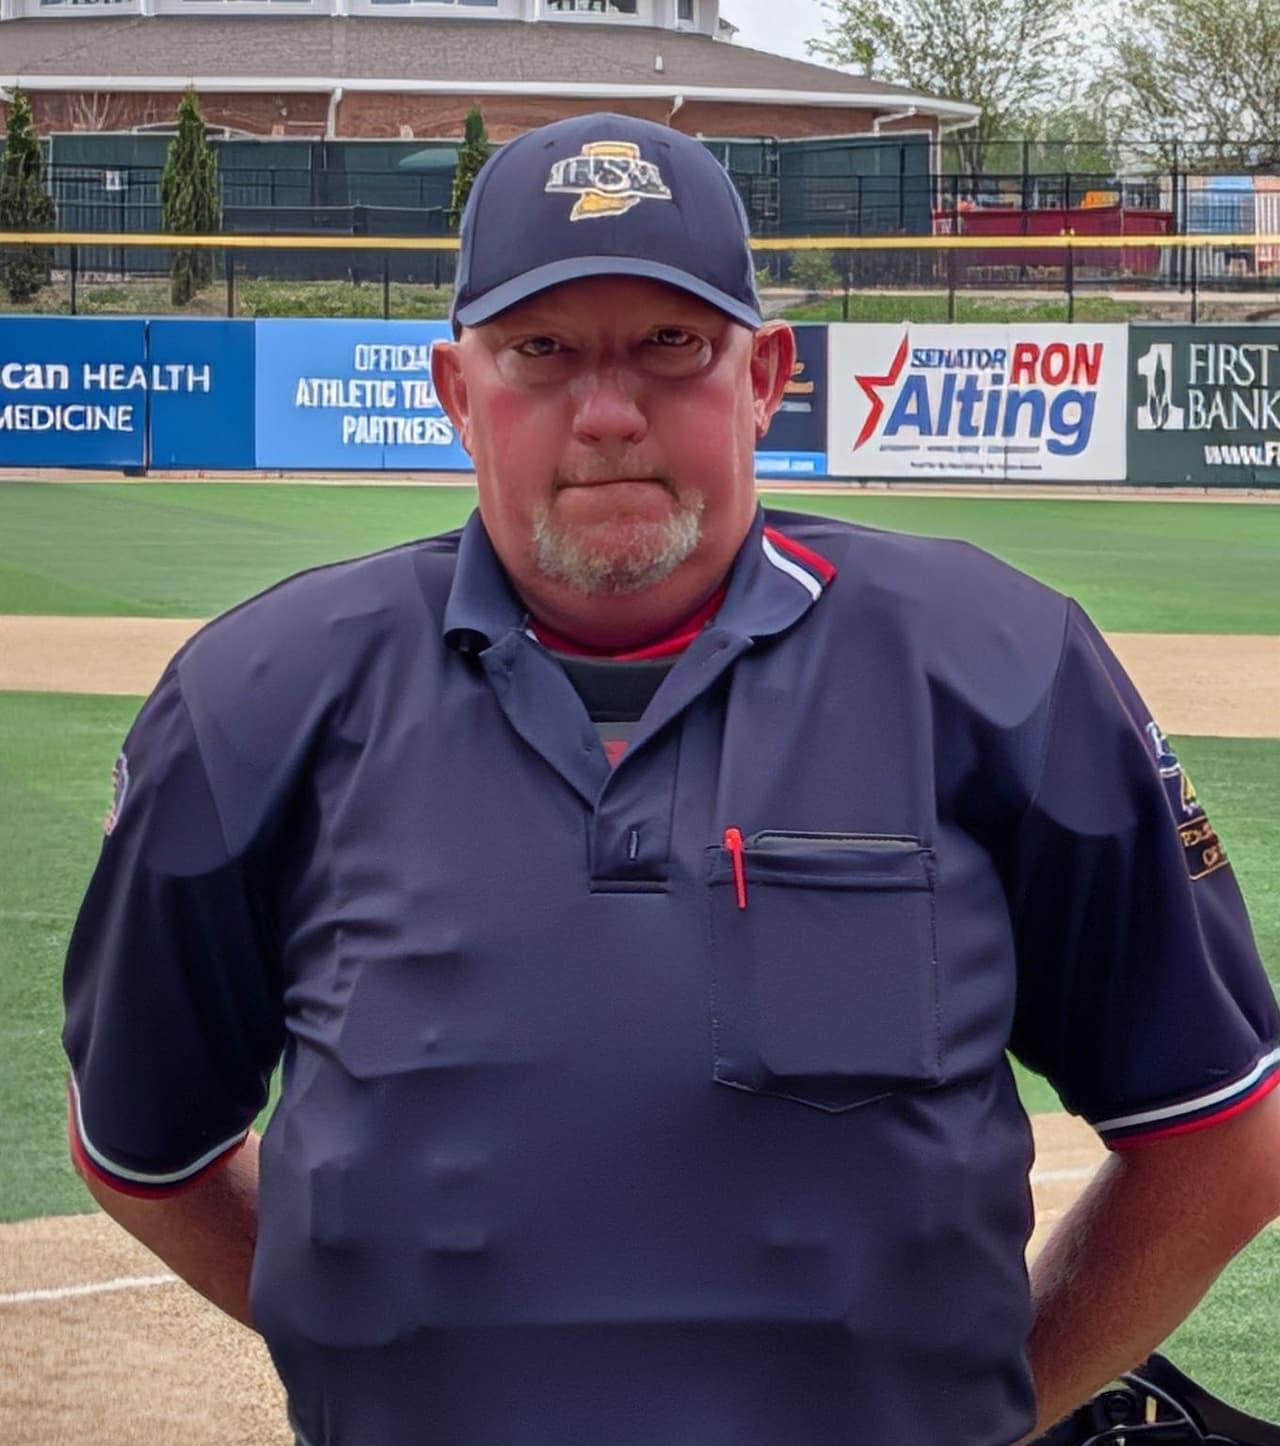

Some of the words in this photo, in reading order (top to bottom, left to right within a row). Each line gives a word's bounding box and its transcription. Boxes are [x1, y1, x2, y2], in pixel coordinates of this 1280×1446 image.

[83, 363, 211, 393] HEALTH
[911, 348, 1006, 371] SENATOR
[1010, 343, 1104, 385] RON
[1189, 344, 1278, 386] FIRST
[296, 377, 396, 408] ATHLETIC
[883, 373, 1096, 457] Alting
